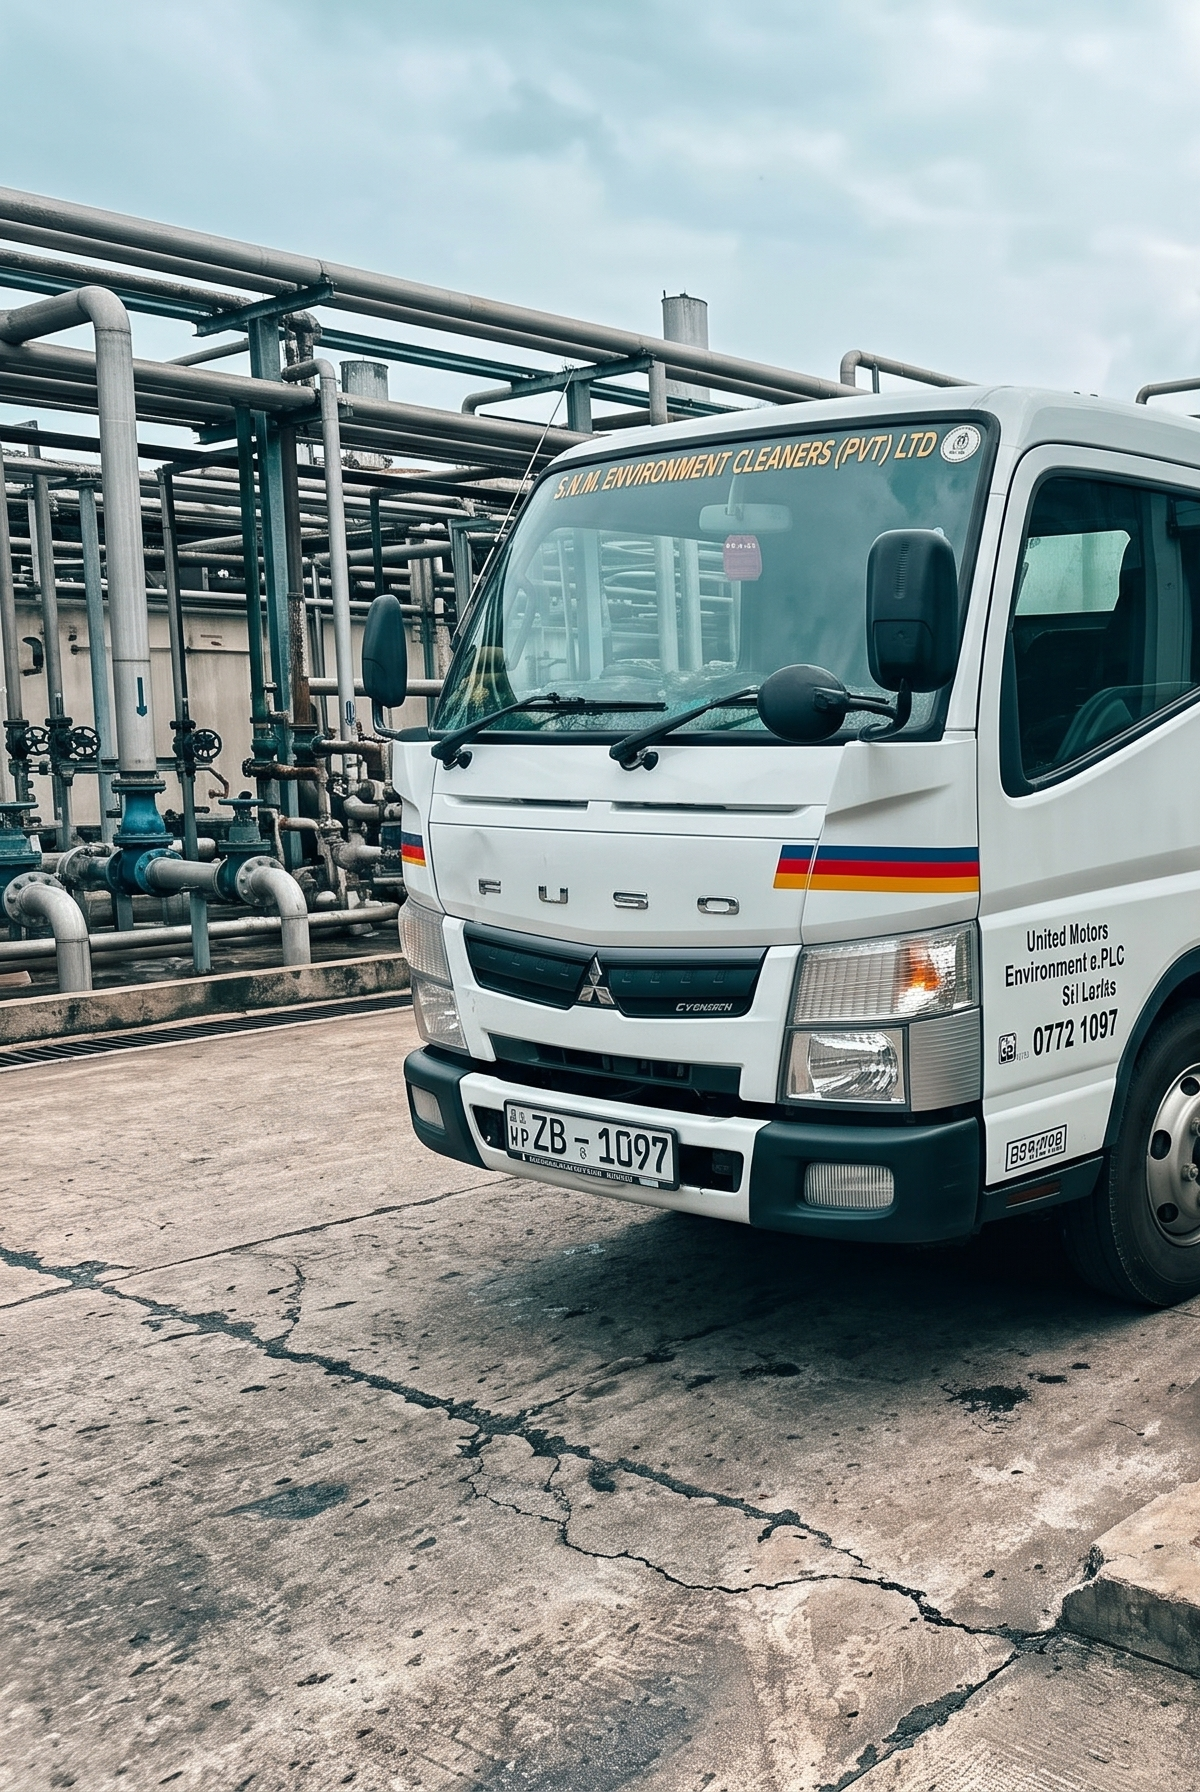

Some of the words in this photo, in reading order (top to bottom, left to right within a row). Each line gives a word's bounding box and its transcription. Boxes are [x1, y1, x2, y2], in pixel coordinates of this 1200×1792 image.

[553, 469, 602, 500] S.N.M.
[600, 451, 733, 491] ENVIRONMENT
[732, 439, 836, 474] CLEANERS
[834, 434, 893, 470] (PVT)
[894, 431, 938, 460] LTD
[478, 878, 740, 916] FUSO
[1026, 925, 1066, 952] United
[1069, 923, 1108, 945] Motors
[1005, 952, 1087, 987] Environment
[1033, 1018, 1074, 1056] 0772
[1080, 1008, 1118, 1044] 1097
[598, 1127, 669, 1174] 1097
